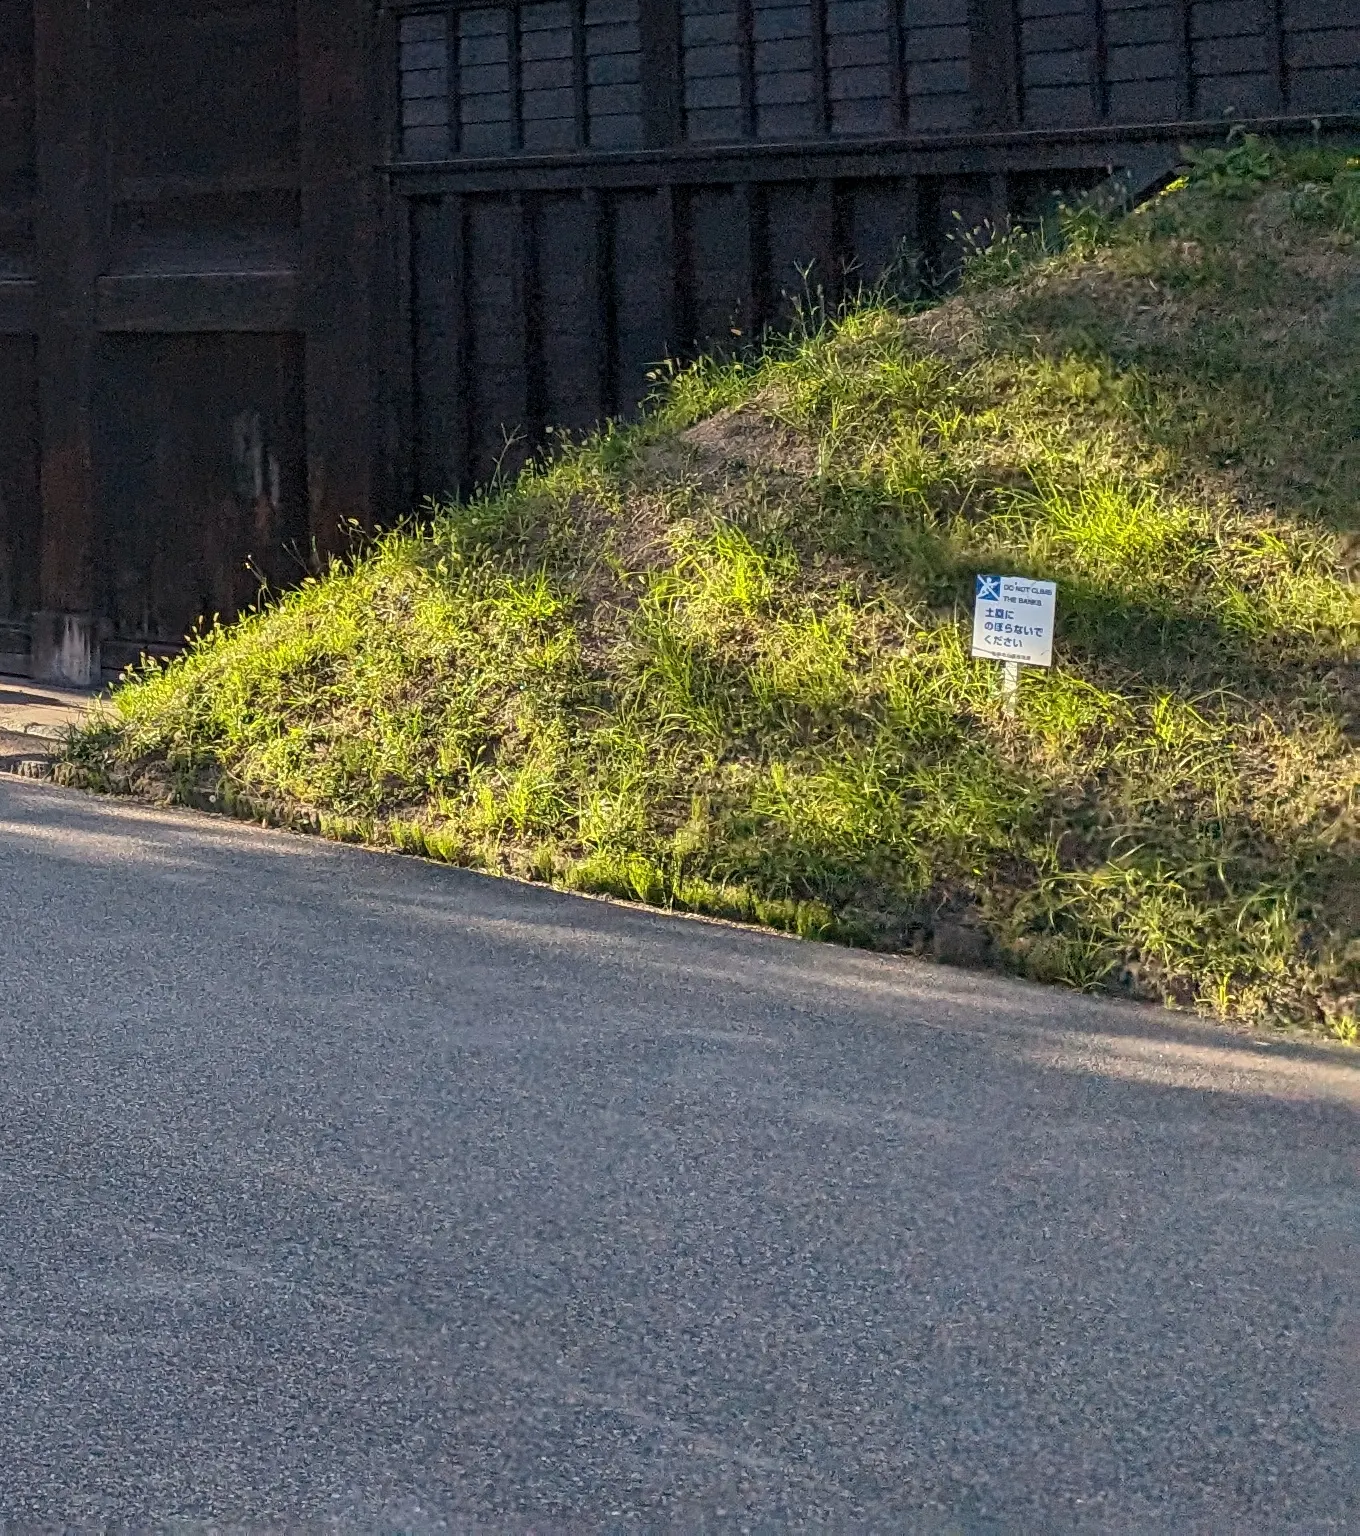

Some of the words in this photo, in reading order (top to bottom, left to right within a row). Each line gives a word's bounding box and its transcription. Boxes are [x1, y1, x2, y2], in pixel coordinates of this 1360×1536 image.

[984, 622, 1043, 637] のぼらないで
[984, 635, 1023, 647] ください
